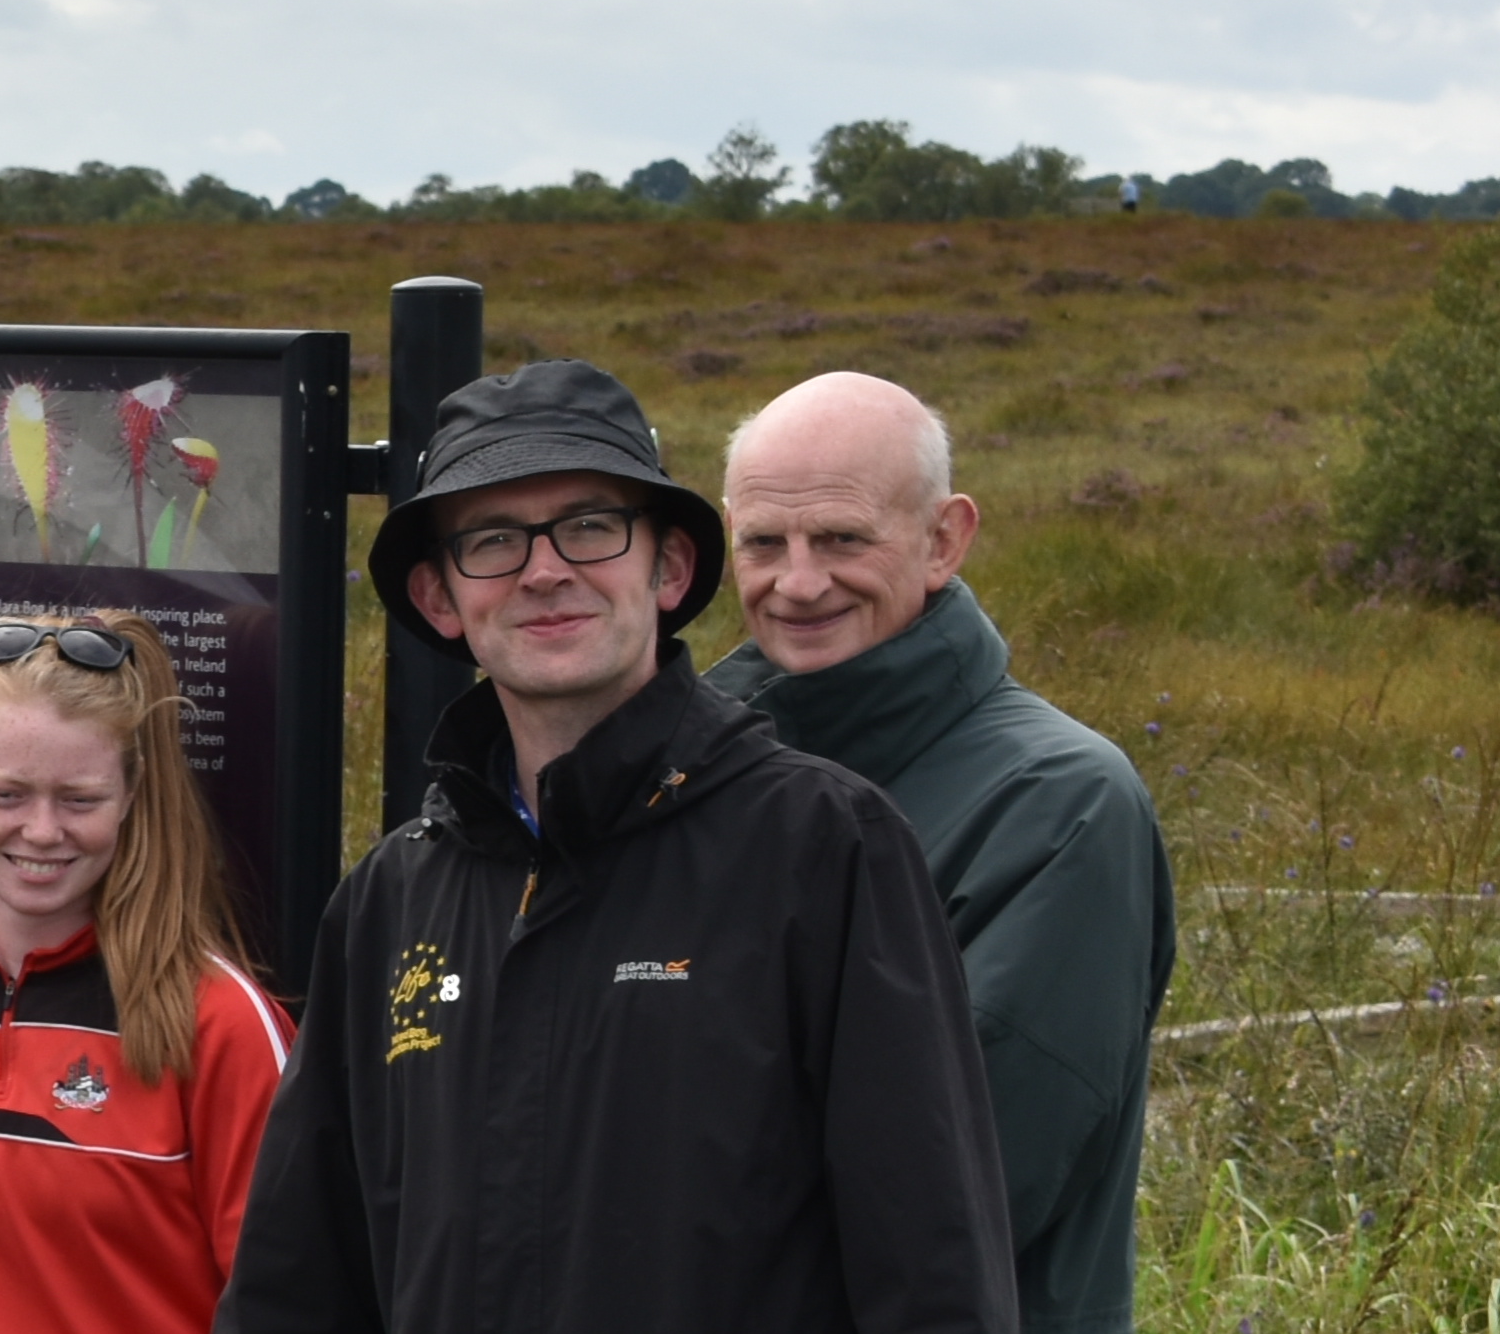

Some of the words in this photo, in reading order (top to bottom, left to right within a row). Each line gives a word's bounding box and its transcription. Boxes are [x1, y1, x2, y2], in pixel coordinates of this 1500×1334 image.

[23, 600, 45, 615] Bog
[140, 605, 190, 627] inspiring
[192, 607, 227, 626] place.
[184, 632, 226, 652] largest
[185, 657, 226, 673] Ireland
[187, 682, 214, 697] such
[217, 686, 226, 698] a
[179, 706, 225, 725] osystem
[180, 733, 192, 744] as
[195, 730, 225, 746] been
[211, 755, 224, 771] of
